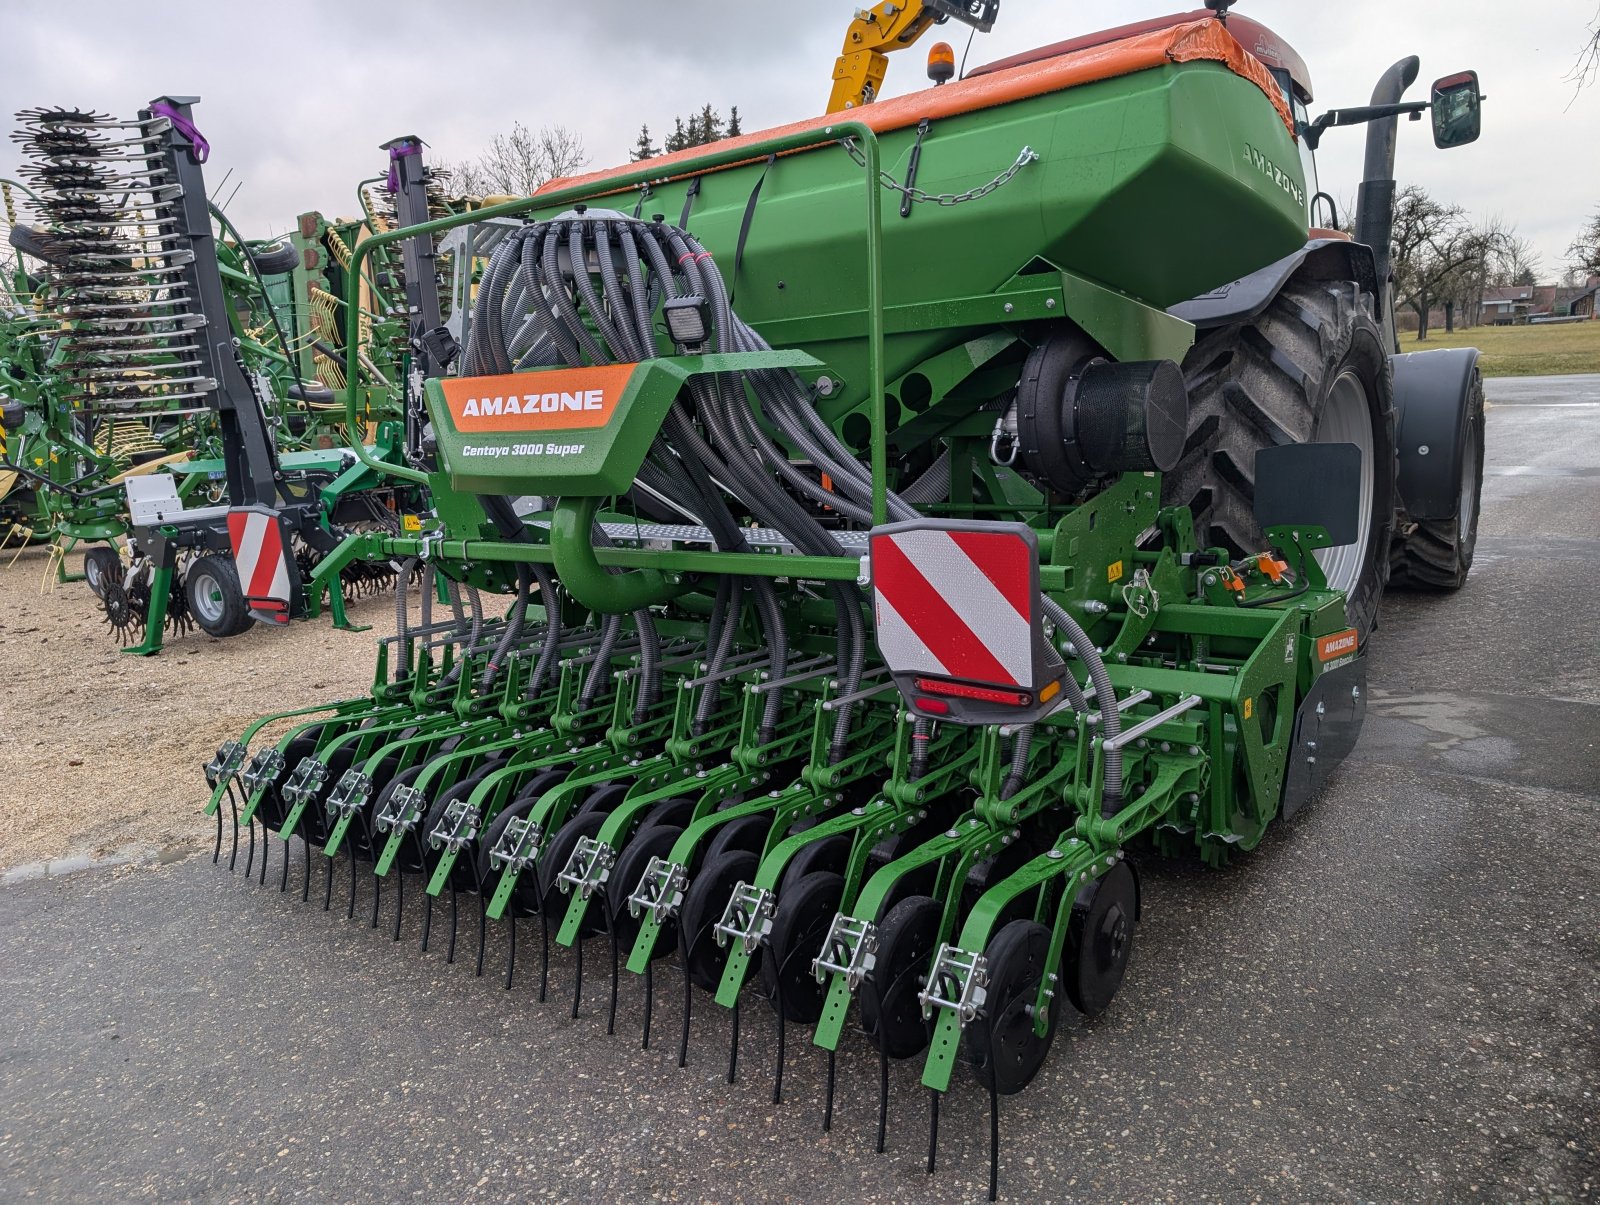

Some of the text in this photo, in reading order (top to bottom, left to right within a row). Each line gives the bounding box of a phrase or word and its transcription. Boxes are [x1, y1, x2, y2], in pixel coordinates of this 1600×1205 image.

[1242, 142, 1304, 208] AMAZONE
[462, 389, 603, 417] AMAZONE
[462, 443, 585, 459] Centaya 3000 Super
[1325, 636, 1354, 654] AMAZONE
